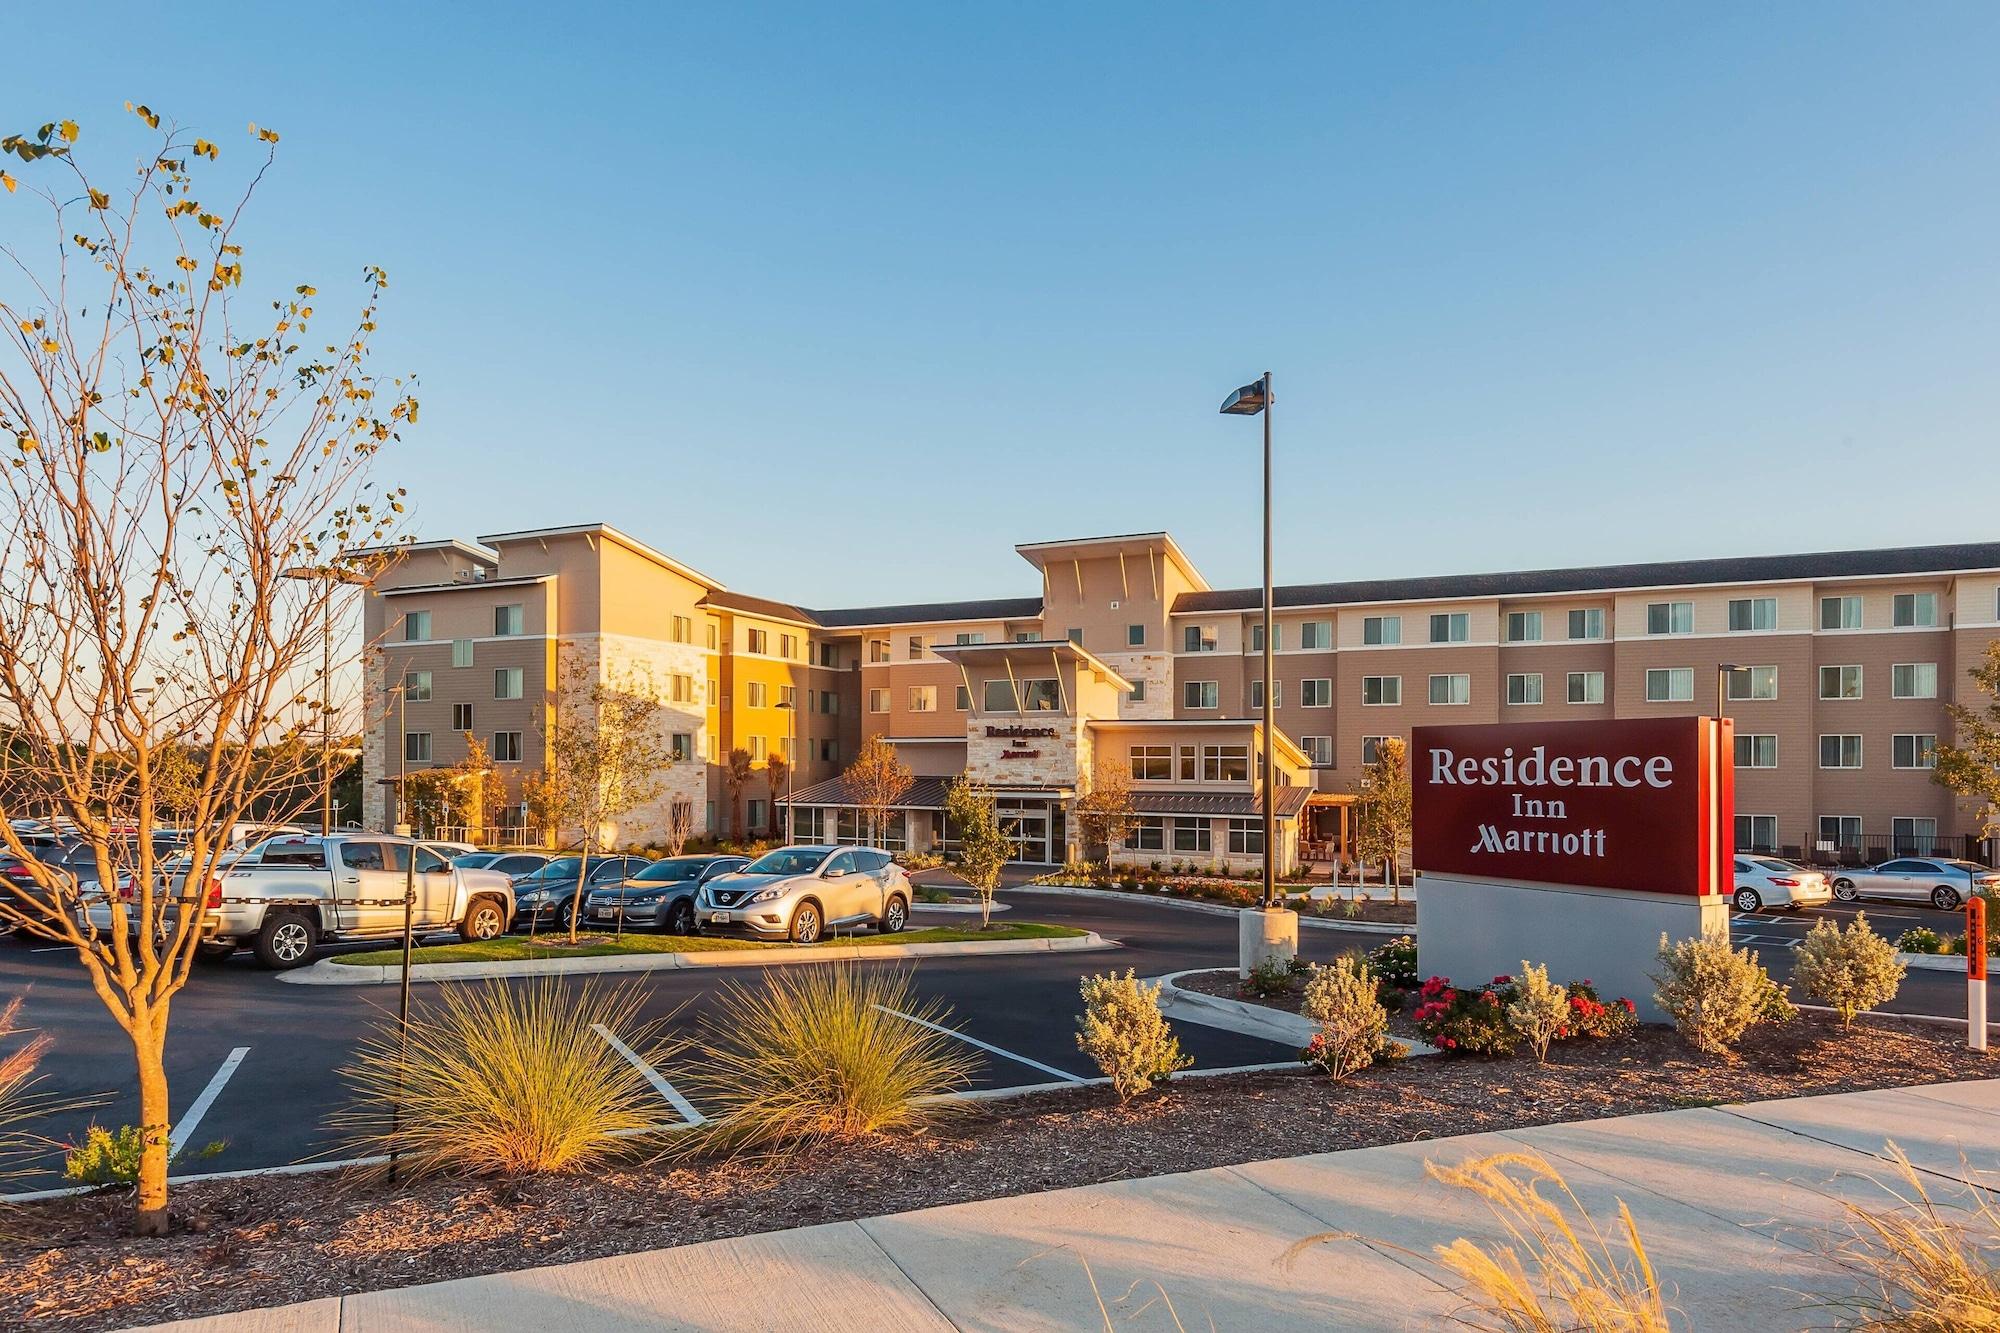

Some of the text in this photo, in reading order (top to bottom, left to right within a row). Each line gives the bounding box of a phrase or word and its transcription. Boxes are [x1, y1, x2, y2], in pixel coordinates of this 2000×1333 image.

[985, 725, 1055, 738] Residence
[1428, 746, 1673, 788] Residence
[1511, 793, 1567, 818] Inn
[1470, 823, 1607, 857] Marriott
